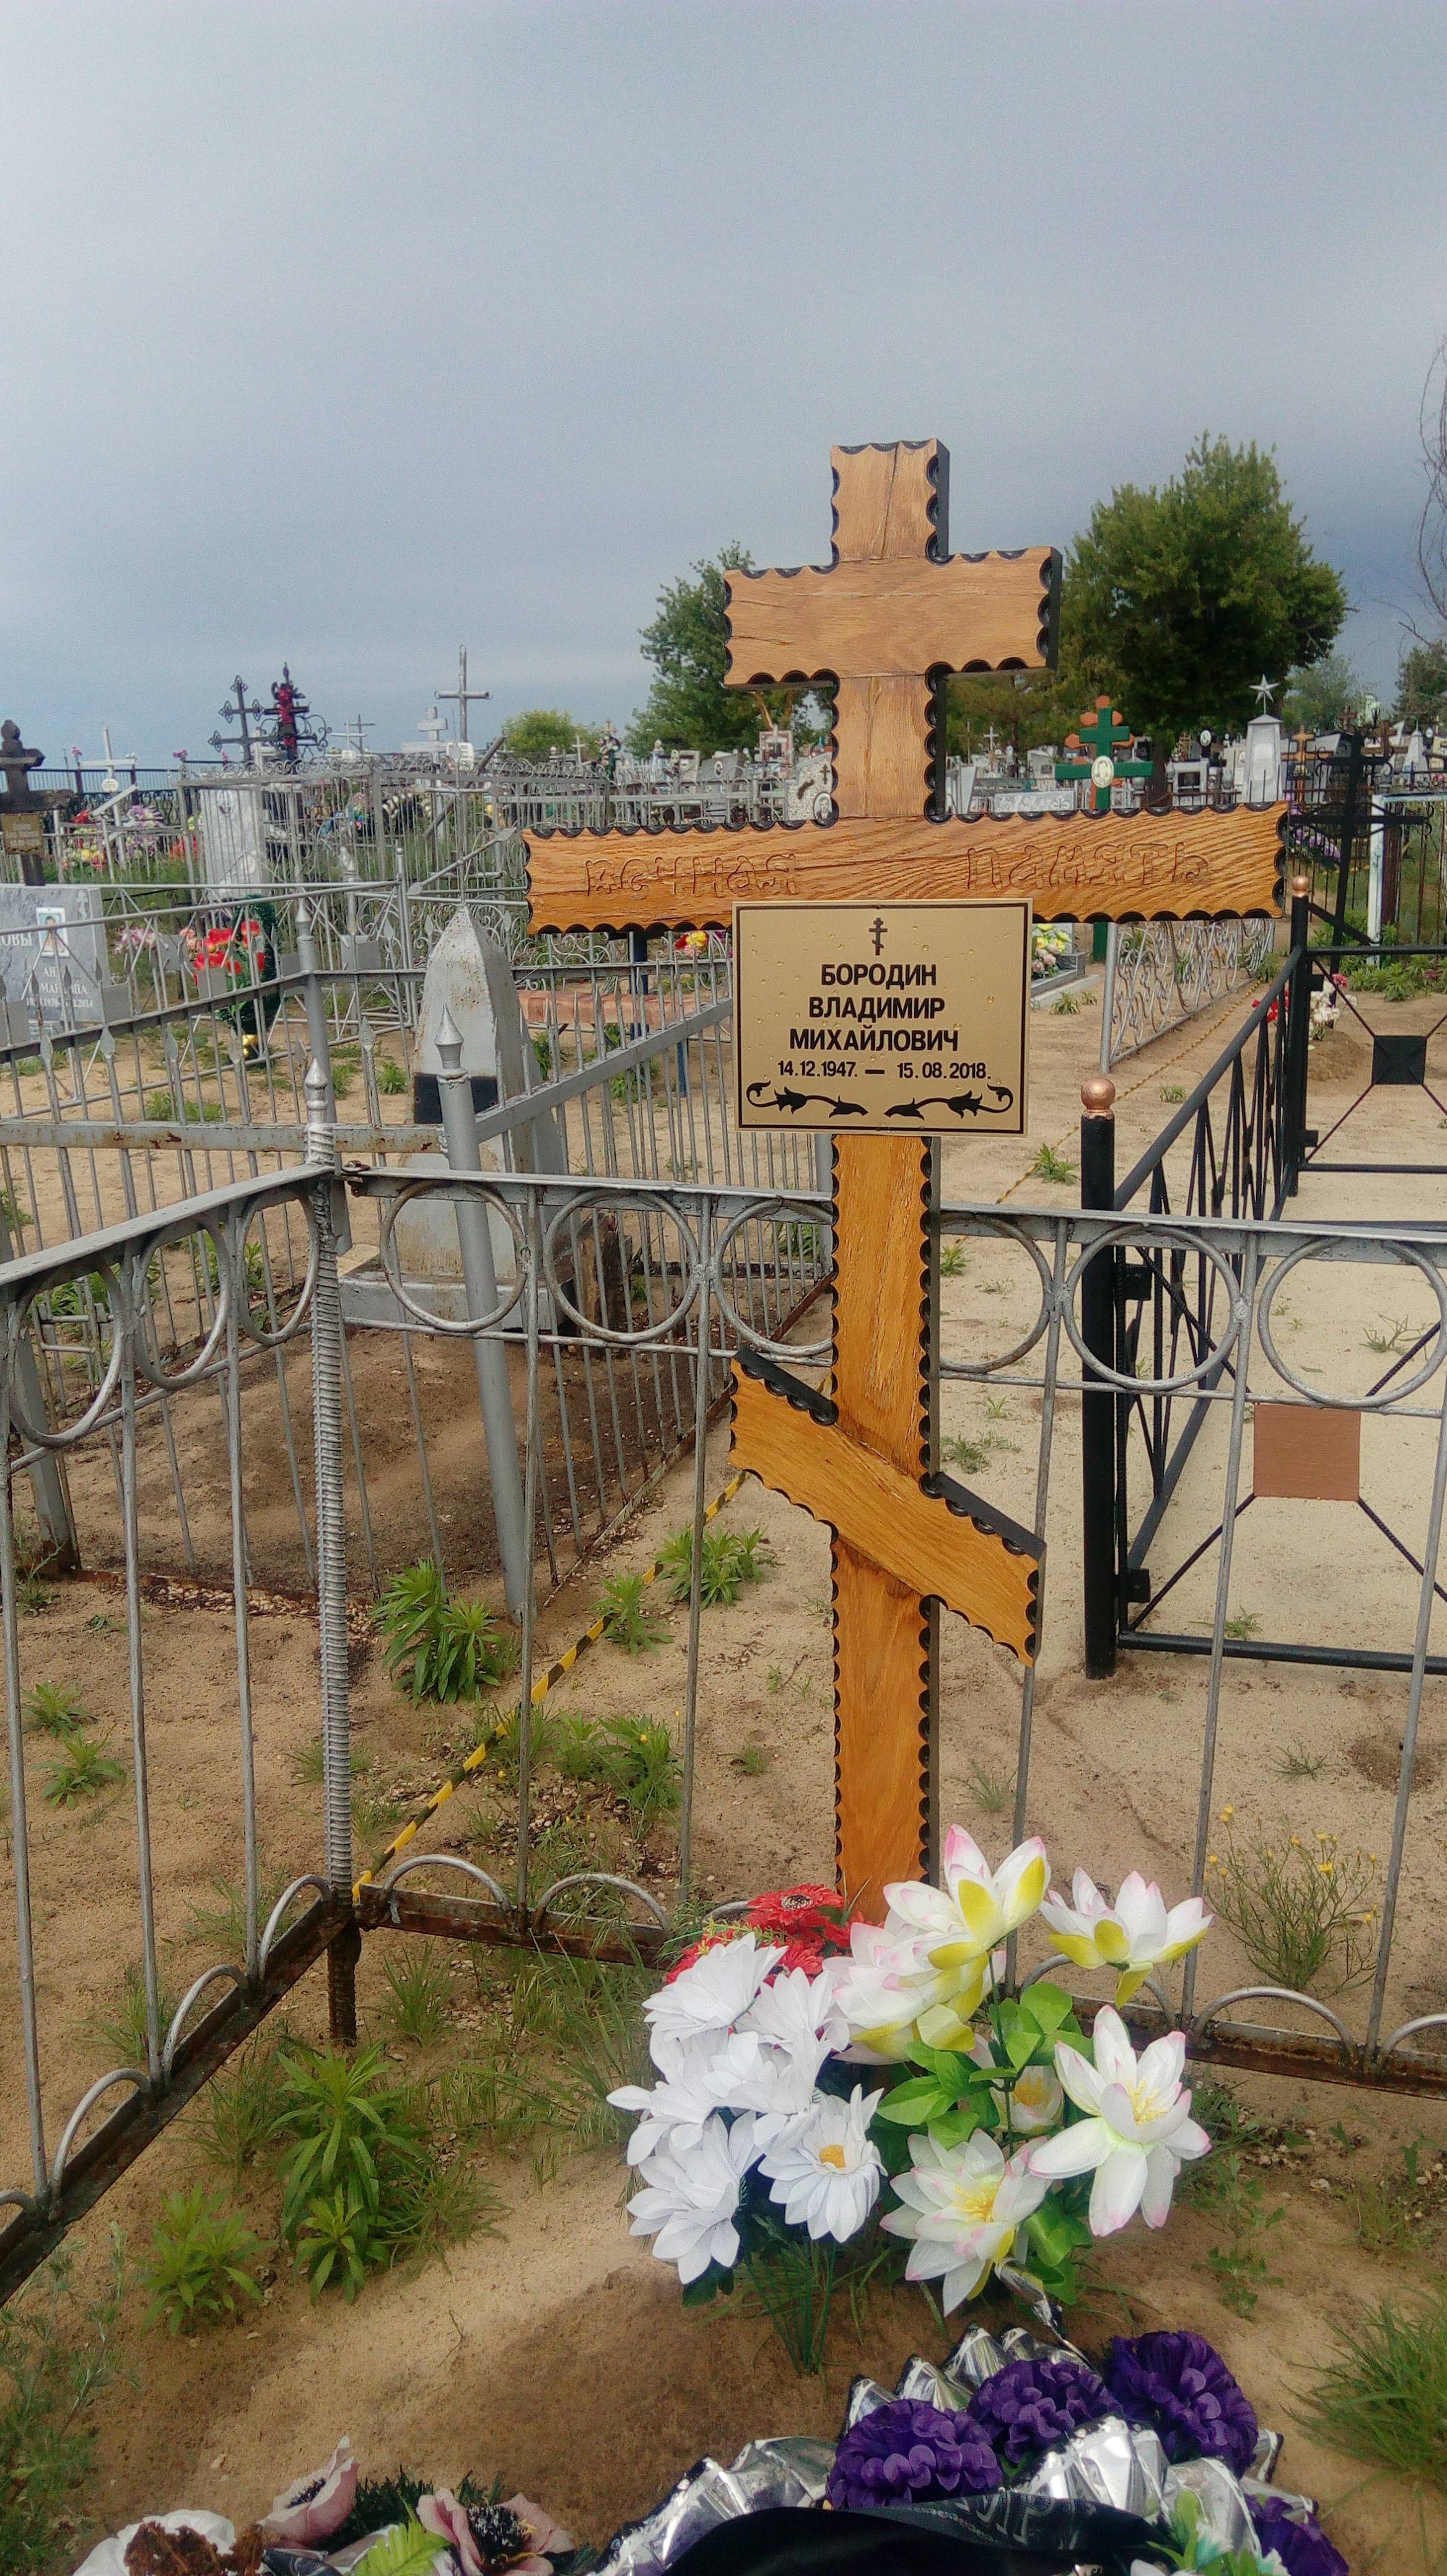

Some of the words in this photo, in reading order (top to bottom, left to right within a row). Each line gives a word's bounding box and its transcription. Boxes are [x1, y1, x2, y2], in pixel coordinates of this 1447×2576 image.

[821, 964, 937, 990] БОРОДИН
[809, 997, 945, 1022] ВЛАДИМИР
[790, 1023, 958, 1051] МИХАЙЛОВИЧ
[777, 1060, 858, 1077] 14.12.1947.
[896, 1061, 991, 1080] 15.08.2018.
